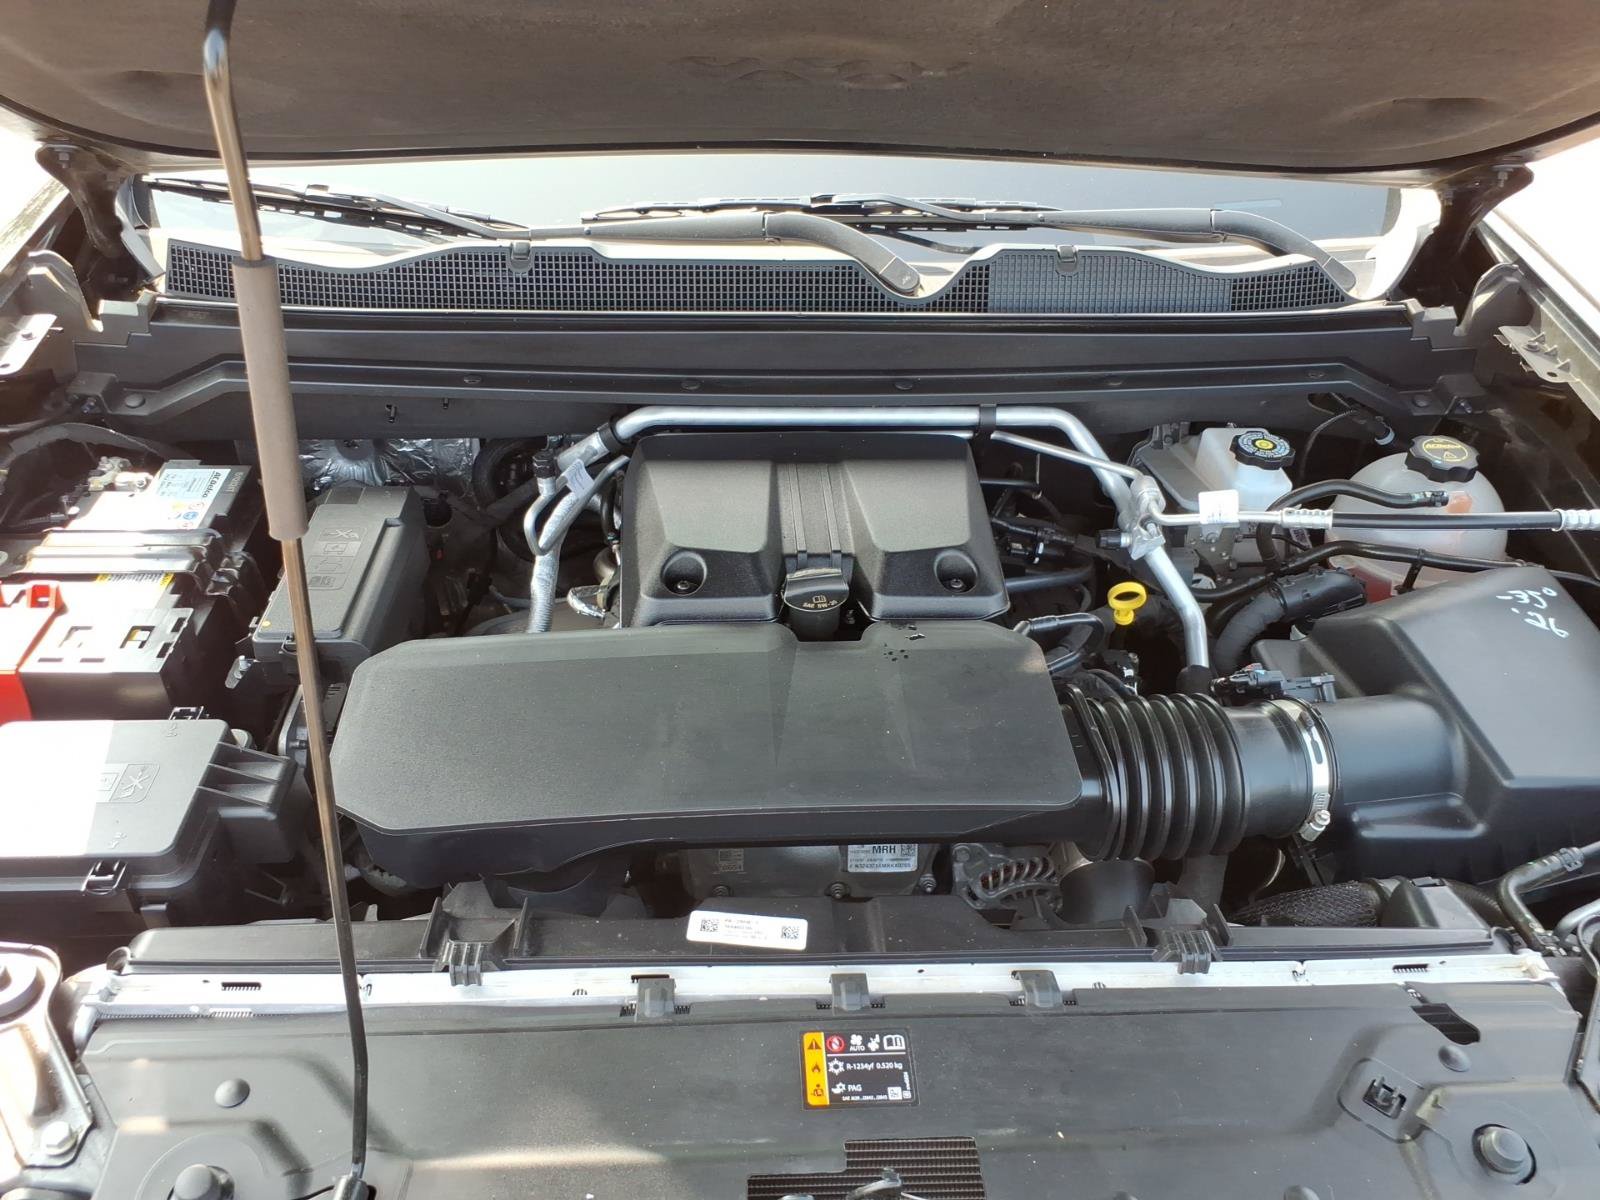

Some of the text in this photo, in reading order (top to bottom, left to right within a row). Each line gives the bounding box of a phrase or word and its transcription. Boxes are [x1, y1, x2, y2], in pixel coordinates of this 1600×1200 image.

[872, 845, 896, 854] MRH
[846, 1062, 874, 1071] R-1234yf
[893, 1062, 903, 1070] kg
[848, 1084, 862, 1092] PAG
